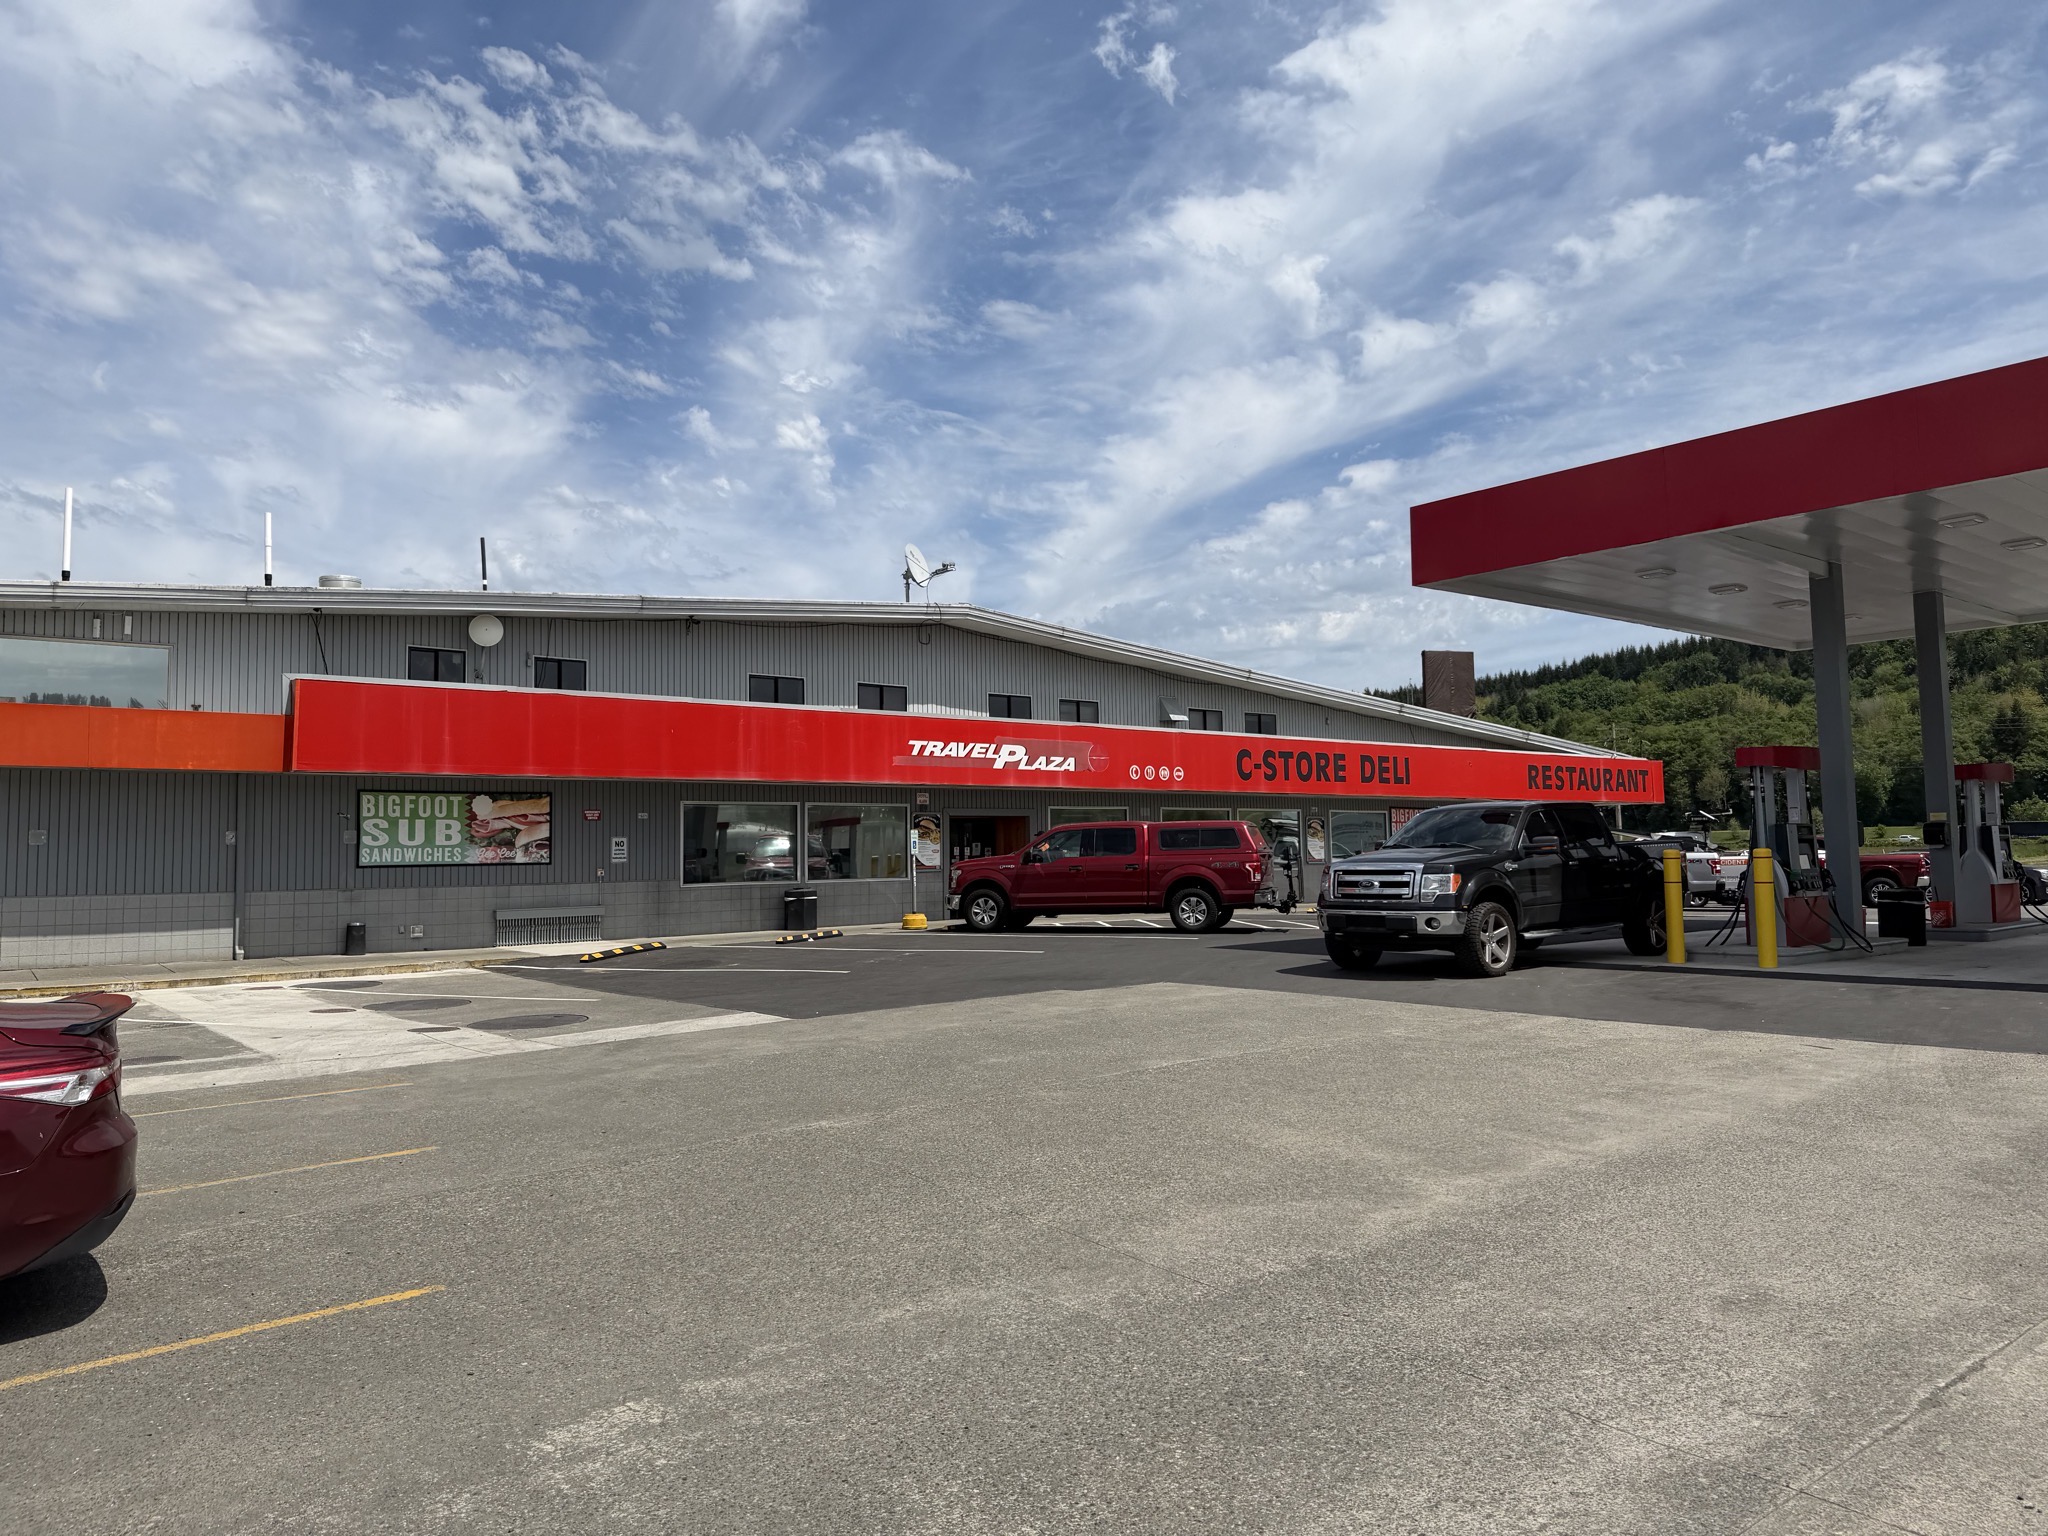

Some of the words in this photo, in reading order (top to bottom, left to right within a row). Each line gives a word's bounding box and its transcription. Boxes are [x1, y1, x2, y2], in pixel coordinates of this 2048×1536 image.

[908, 740, 1001, 758] TRAVEL
[993, 744, 1076, 772] PLAZA
[1236, 748, 1347, 782] C-STORE
[1360, 754, 1411, 785] DELI
[1527, 764, 1649, 793] RESTAURANT
[362, 794, 463, 818] BIGFOOT
[362, 818, 462, 846] SUB
[614, 840, 625, 848] NO
[361, 847, 462, 863] SANDWICHES
